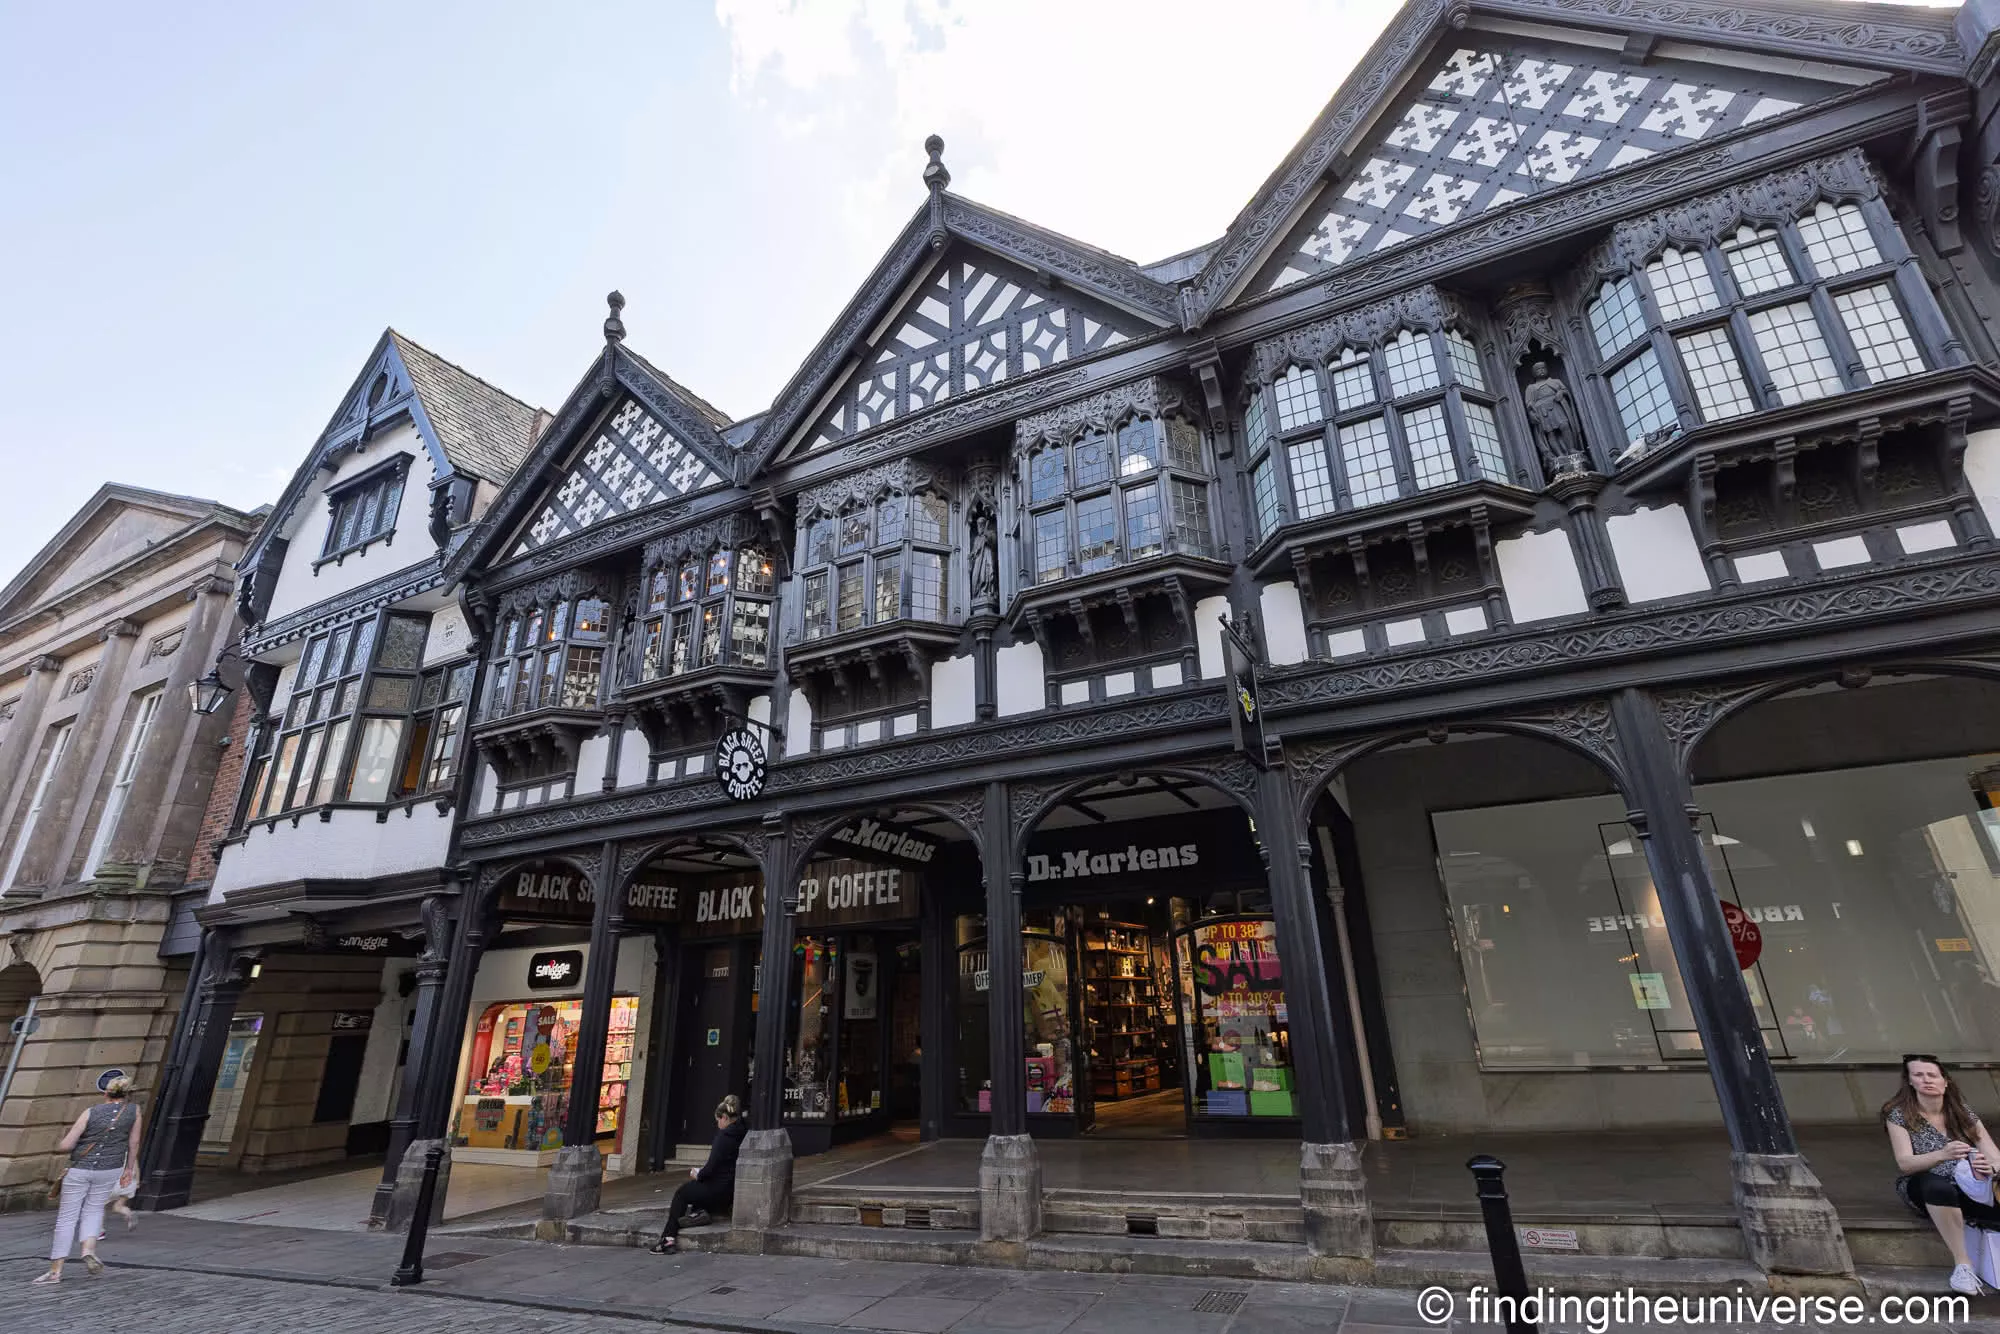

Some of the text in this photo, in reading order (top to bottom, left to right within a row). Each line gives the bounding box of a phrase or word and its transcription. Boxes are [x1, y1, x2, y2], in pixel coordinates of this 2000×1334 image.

[719, 732, 764, 767] BLACK SHEEP
[728, 776, 763, 800] COFFEE
[1062, 844, 1199, 877] Martens
[517, 872, 572, 900] BLACK
[628, 883, 678, 909] COFFEE
[696, 886, 754, 922] BLACK
[827, 869, 900, 910] COFFEE
[1221, 925, 1237, 939] TO
[1228, 991, 1242, 1006] TO
[538, 1016, 556, 1026] SALE
